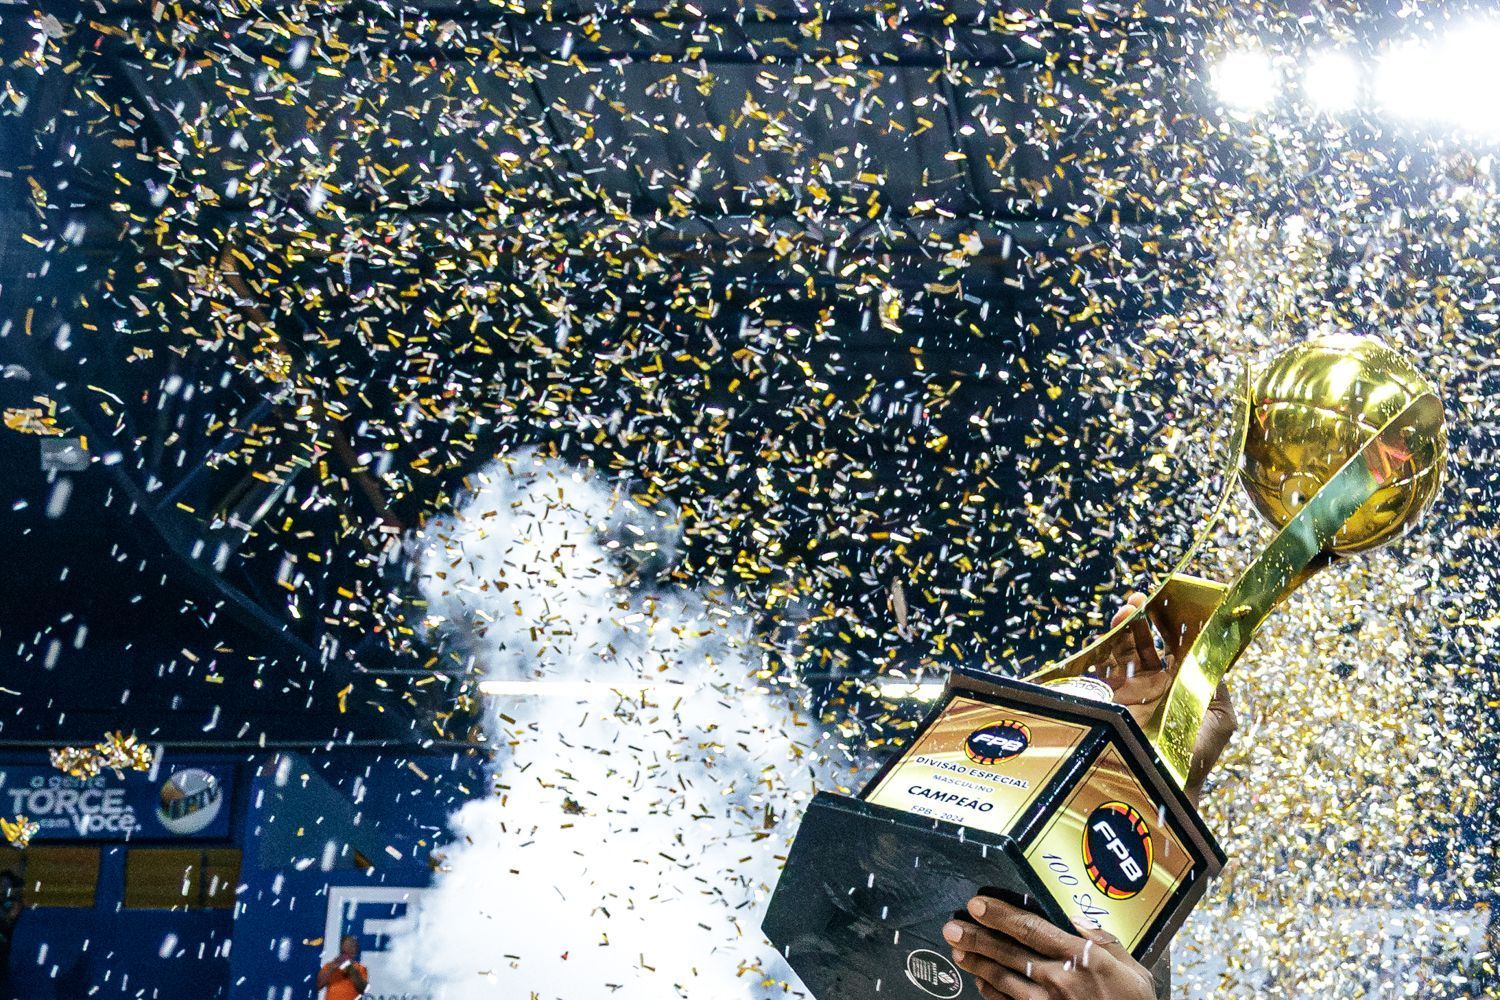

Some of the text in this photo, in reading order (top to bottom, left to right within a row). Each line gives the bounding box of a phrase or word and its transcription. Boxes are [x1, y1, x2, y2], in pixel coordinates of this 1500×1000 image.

[972, 733, 1024, 752] FPB
[932, 774, 994, 793] MASCULINO
[969, 769, 1030, 789] ESPECIAL
[1092, 820, 1143, 881] FPB
